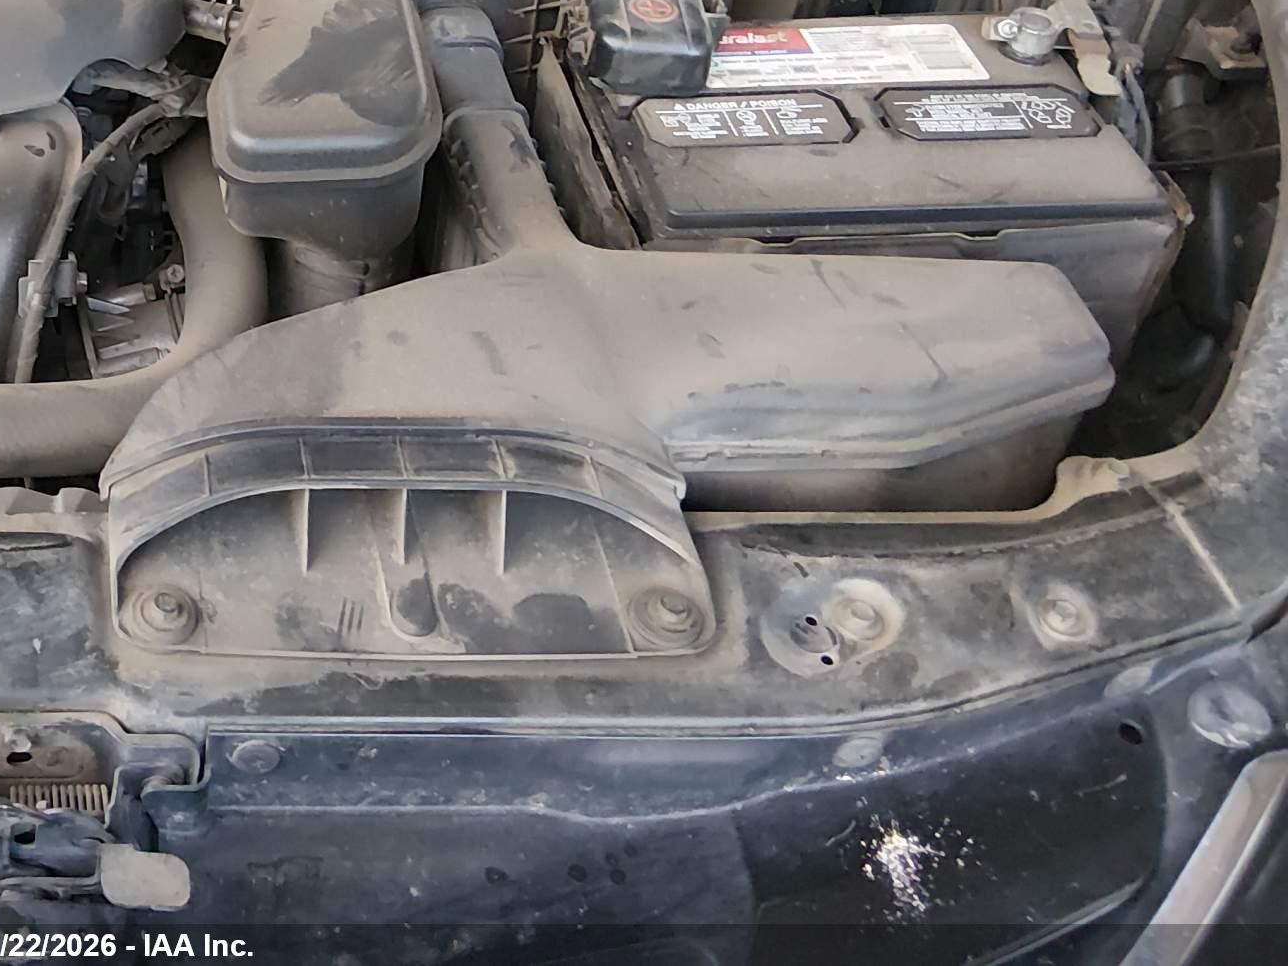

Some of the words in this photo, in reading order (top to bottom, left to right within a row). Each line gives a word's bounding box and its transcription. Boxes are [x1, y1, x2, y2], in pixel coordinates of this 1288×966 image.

[718, 31, 788, 45] uralast
[685, 101, 739, 111] DANGER
[748, 99, 797, 108] POISON
